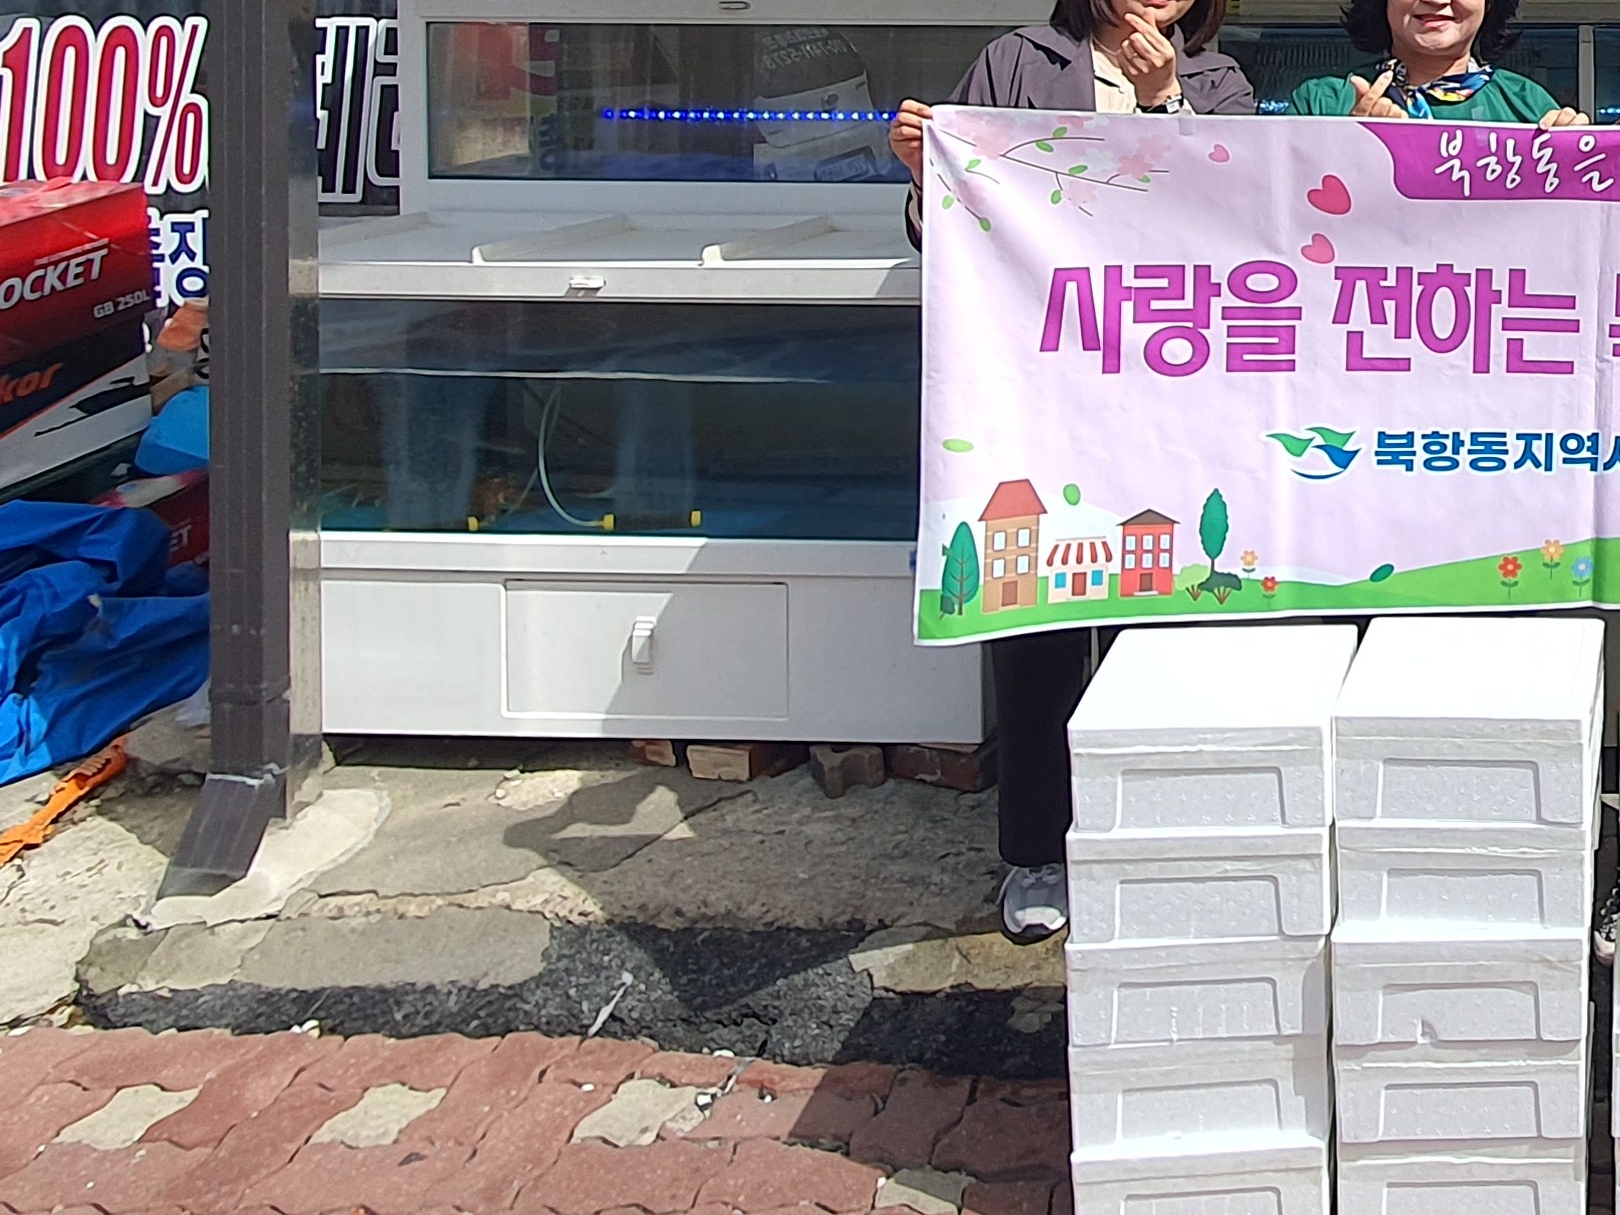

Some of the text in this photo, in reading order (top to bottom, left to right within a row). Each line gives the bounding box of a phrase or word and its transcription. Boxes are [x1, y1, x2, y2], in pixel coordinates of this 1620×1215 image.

[0, 17, 208, 191] 100%
[93, 288, 150, 318] GB 250L
[1039, 260, 1302, 377] 사랑을
[1331, 262, 1581, 375] 전하는
